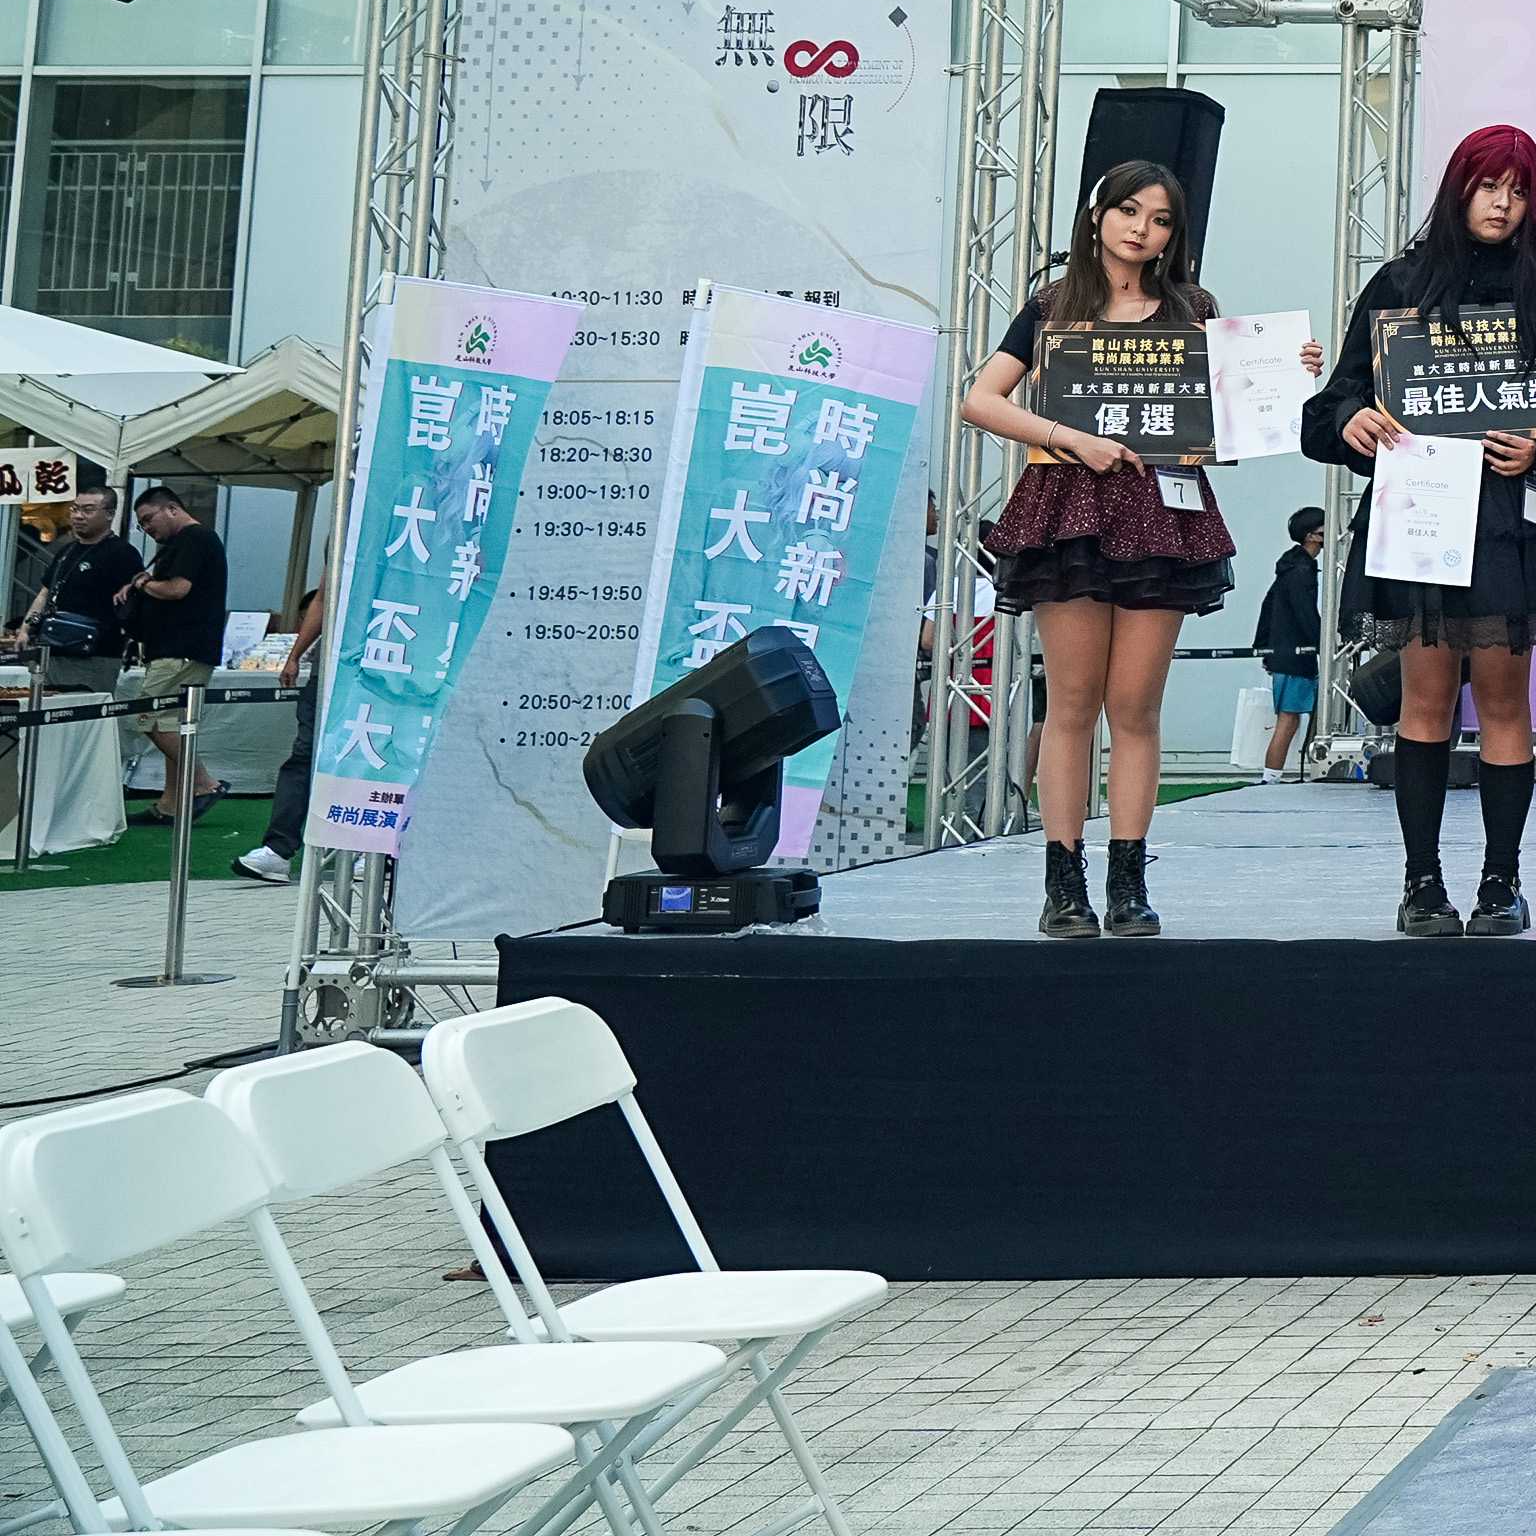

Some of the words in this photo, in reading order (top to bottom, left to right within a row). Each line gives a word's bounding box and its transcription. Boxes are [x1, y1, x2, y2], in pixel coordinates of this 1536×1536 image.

[1092, 338, 1185, 352] 崑山科技大學
[1431, 332, 1519, 347] 時尚演事業
[1092, 353, 1185, 365] 時尚展演事業系
[1072, 382, 1207, 395] 崑大盃時尚新星大賽
[541, 410, 655, 427] 18:05~18:15
[1095, 403, 1175, 437] 優選
[538, 446, 653, 464] 18:20~18:30
[536, 483, 650, 502] 19:00~19:10
[1174, 482, 1184, 503] 7
[533, 521, 647, 539] 19:30~19:45
[527, 584, 643, 602] 19:45~19:50
[523, 624, 640, 642] 19:50~20:50
[516, 730, 601, 749] 21:00~2
[326, 805, 411, 832] 時尚展演
